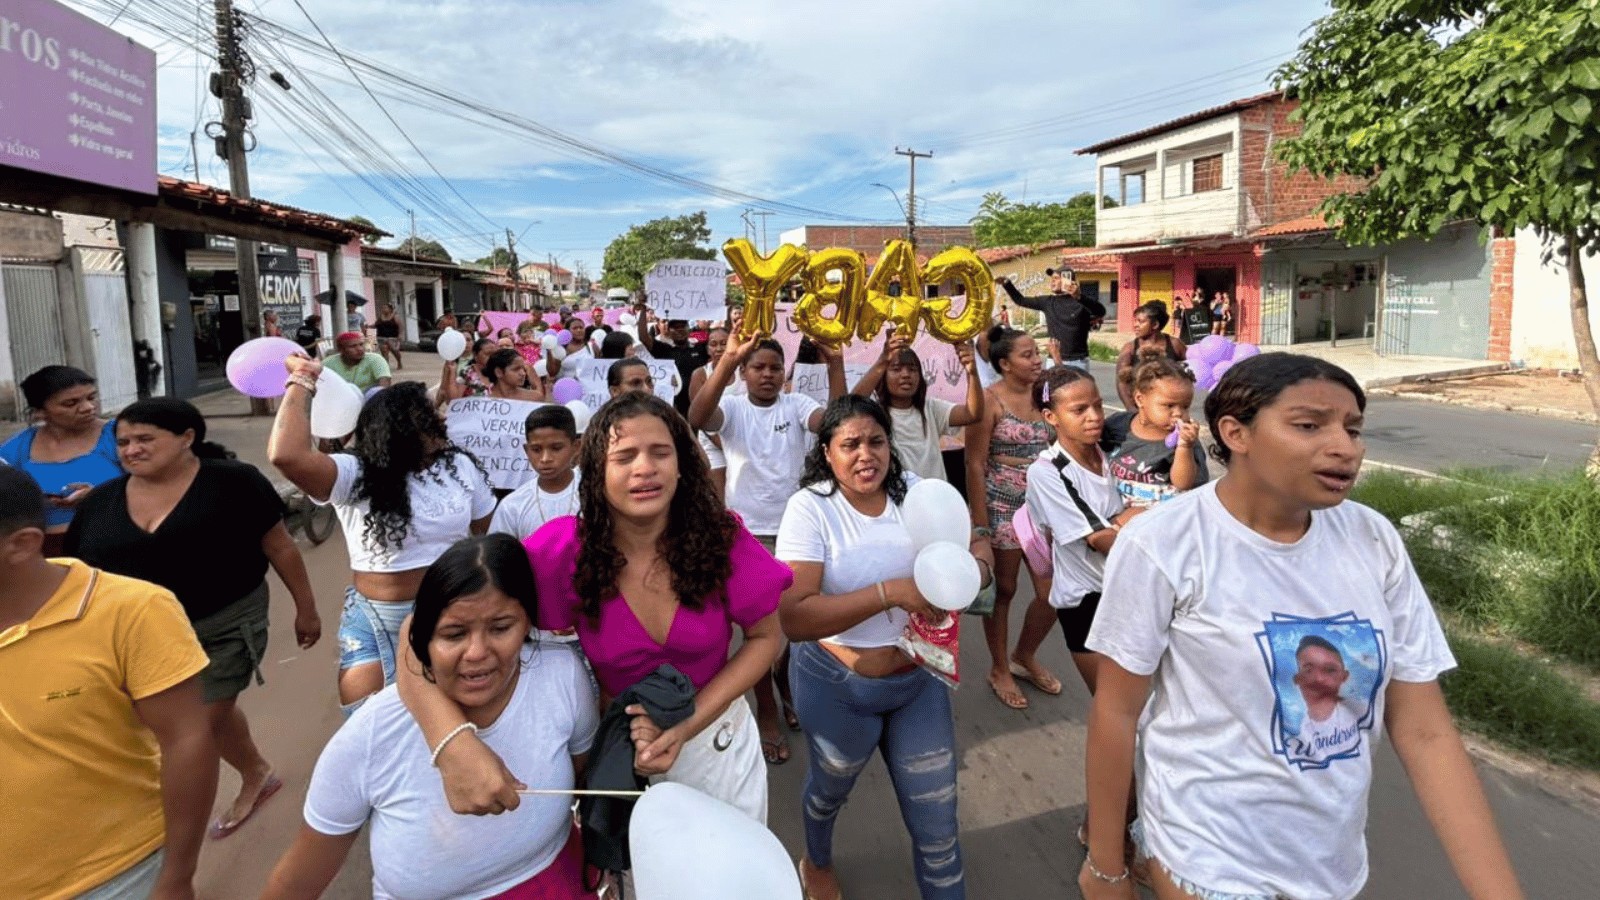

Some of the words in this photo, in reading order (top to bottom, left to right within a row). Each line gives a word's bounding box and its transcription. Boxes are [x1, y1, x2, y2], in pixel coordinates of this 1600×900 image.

[649, 289, 709, 309] BASTA
[464, 435, 502, 450] PARA
[511, 437, 520, 449] O
